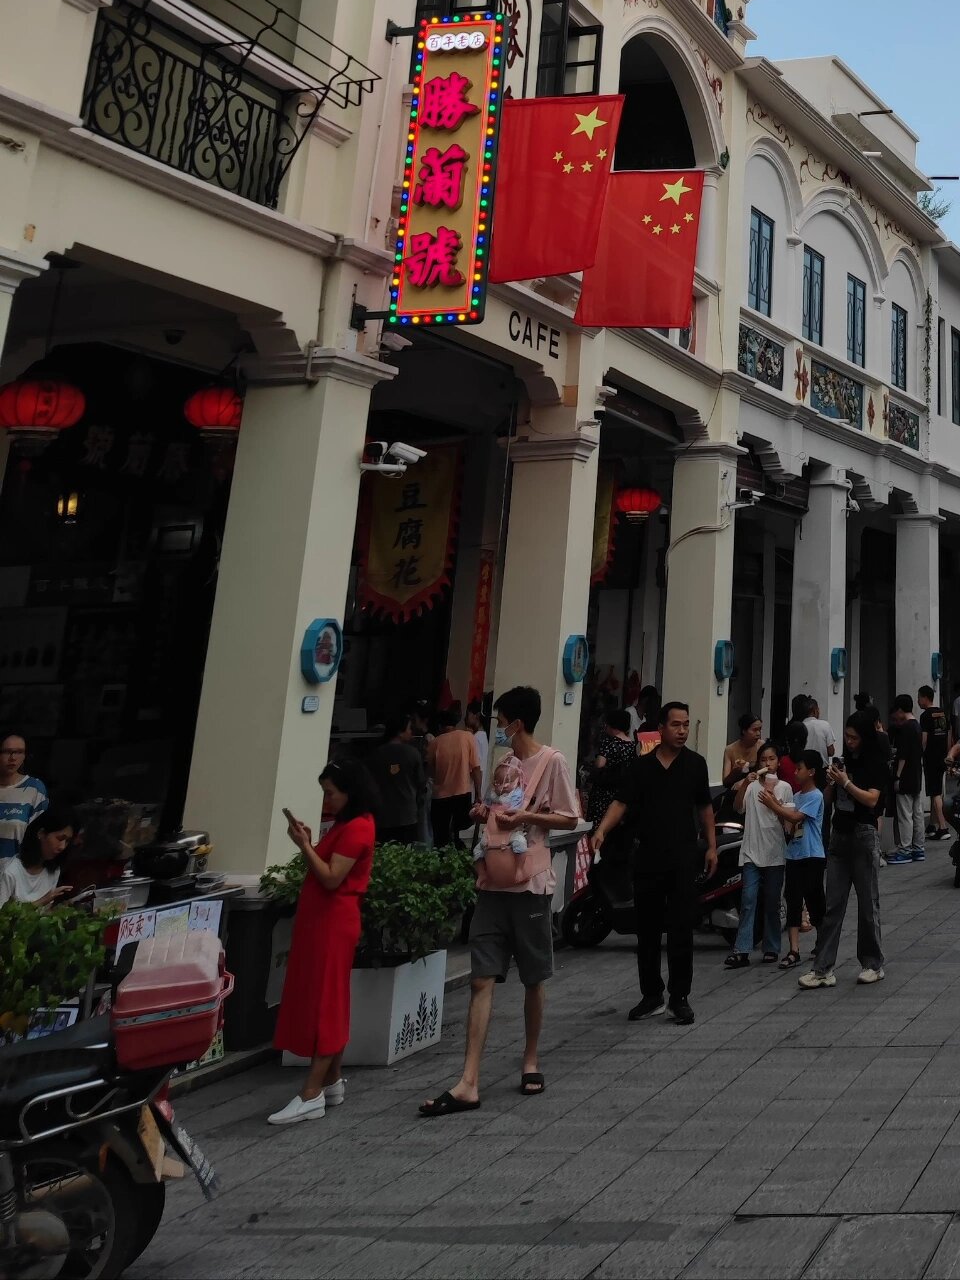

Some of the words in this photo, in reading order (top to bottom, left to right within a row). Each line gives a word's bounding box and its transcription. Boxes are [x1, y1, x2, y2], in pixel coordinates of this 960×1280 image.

[428, 33, 483, 49] 百年老店
[404, 71, 482, 291] 勝蘭號
[508, 310, 561, 359] CAFE
[391, 481, 426, 589] 豆腐花
